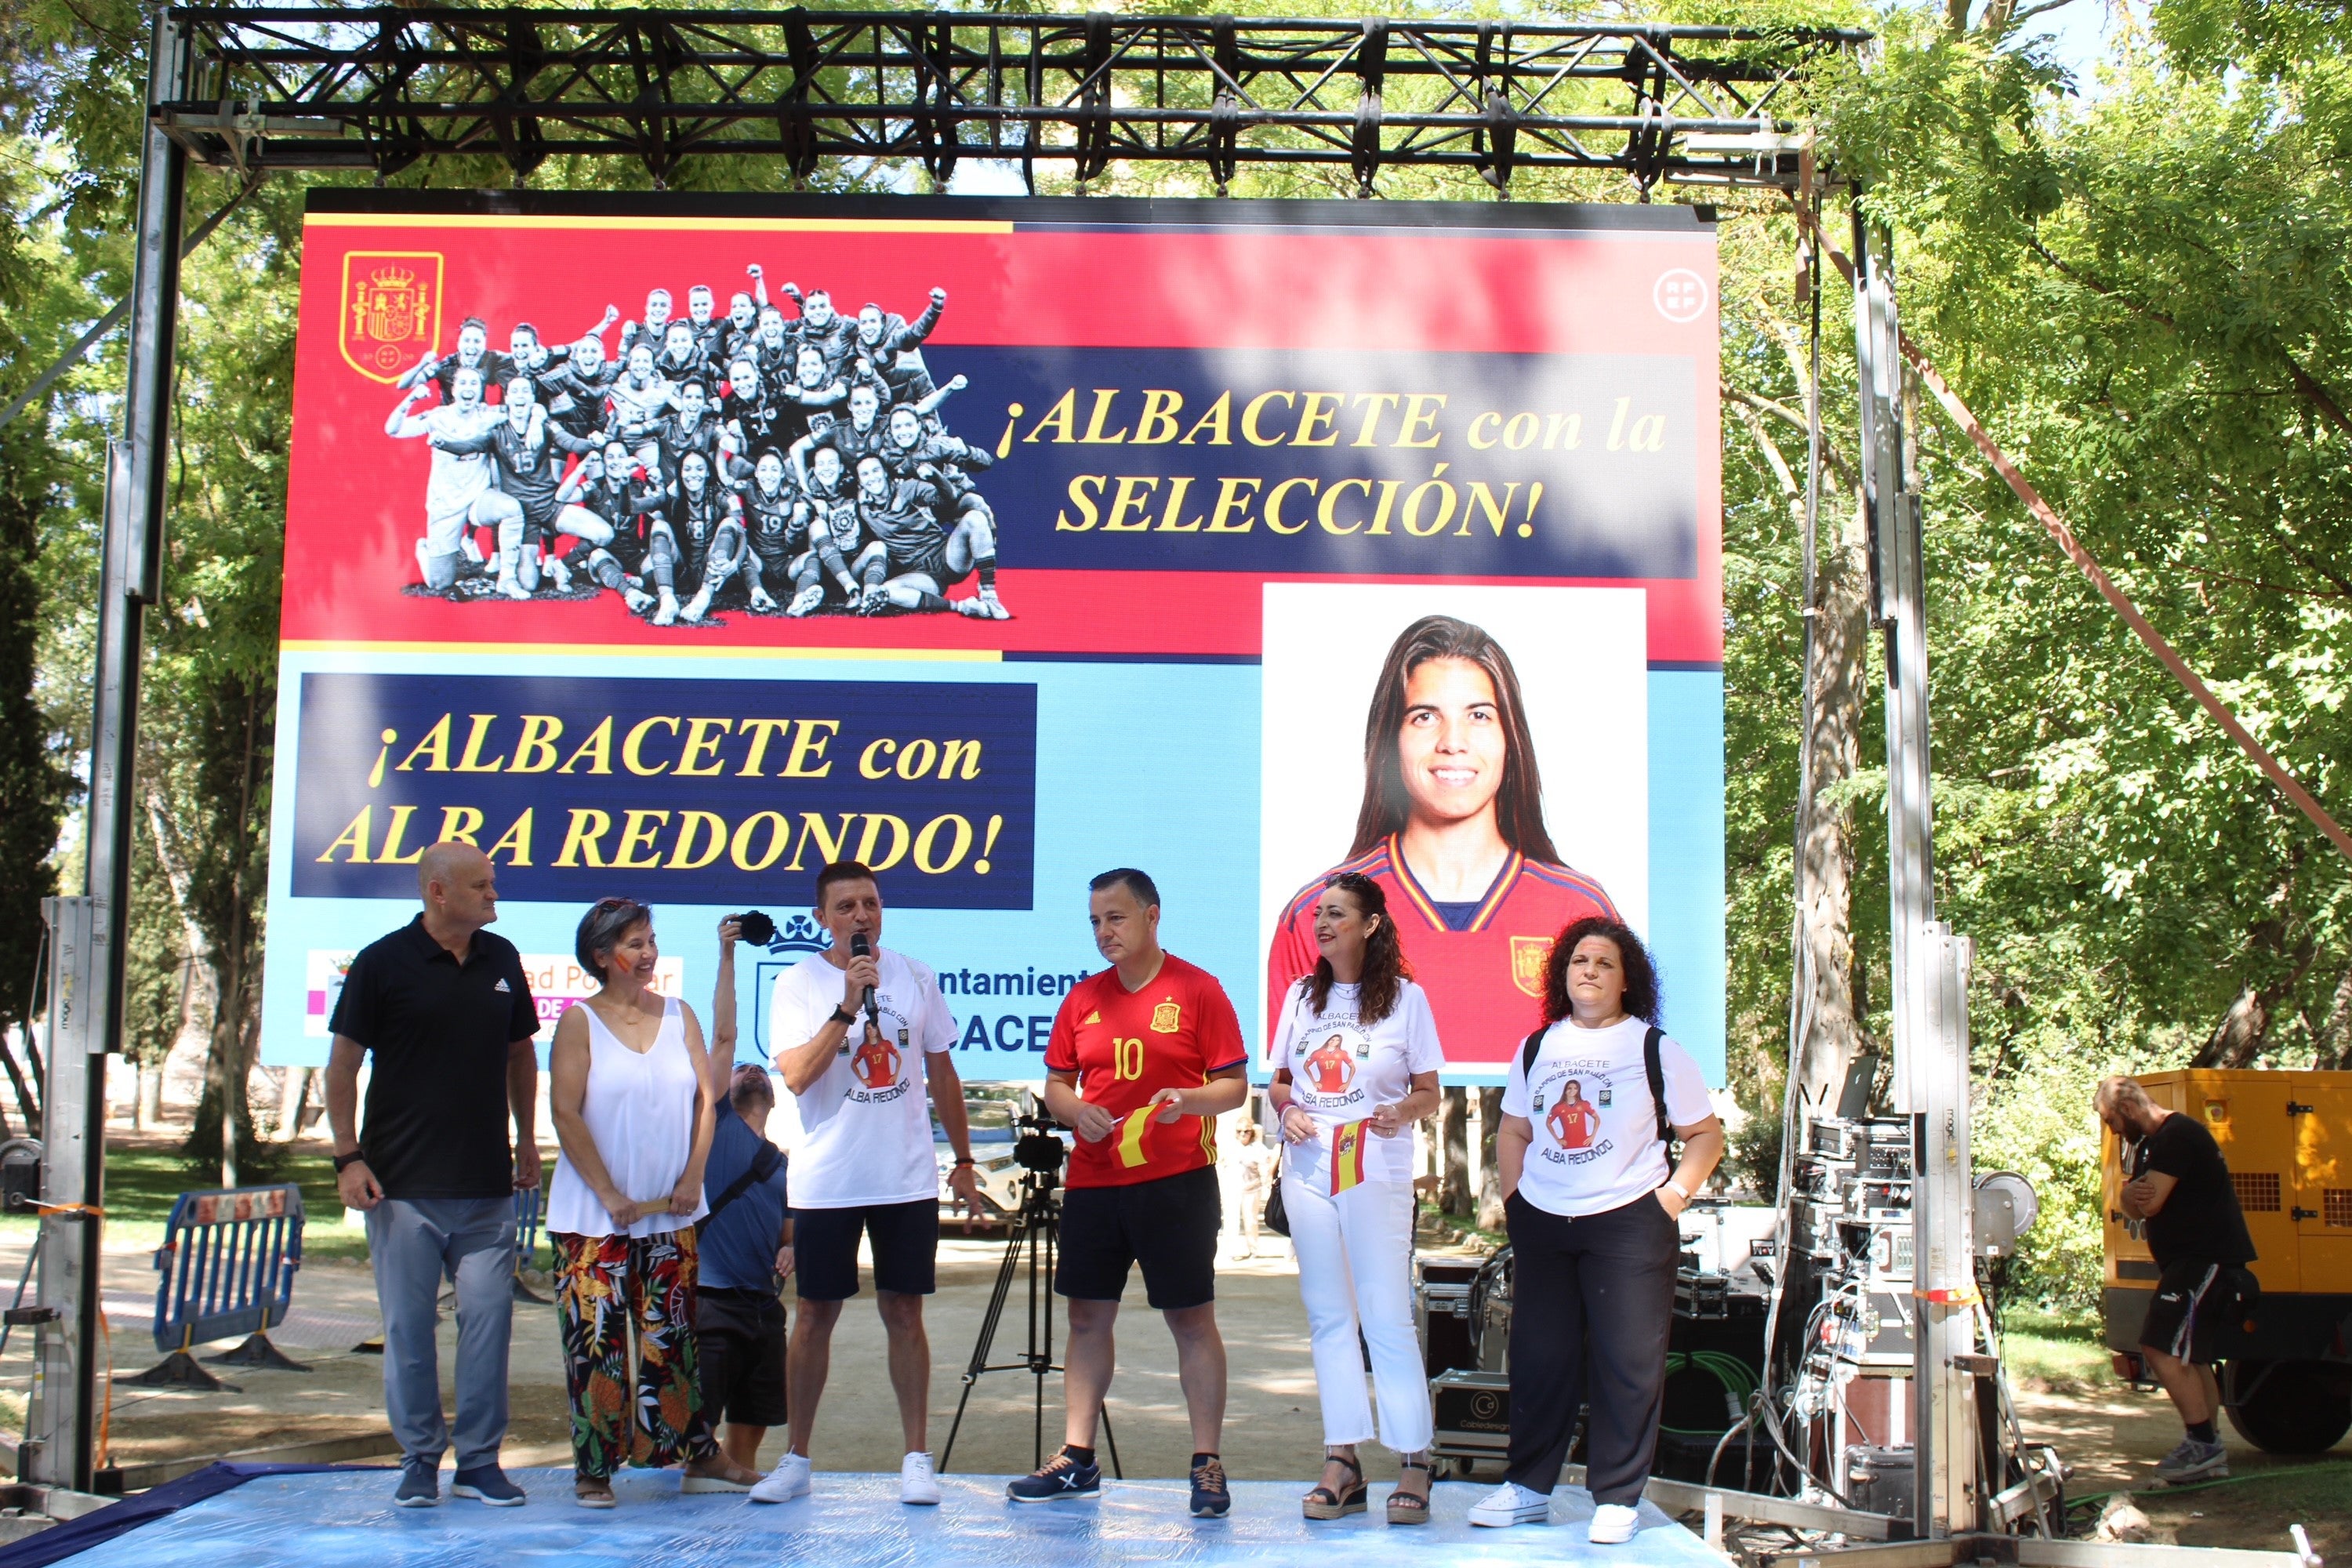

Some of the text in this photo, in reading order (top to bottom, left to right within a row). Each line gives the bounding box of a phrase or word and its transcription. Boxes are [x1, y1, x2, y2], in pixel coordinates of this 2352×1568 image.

[996, 388, 1667, 459] ¡ALBACETE con la
[513, 451, 535, 473] 15
[1055, 463, 1544, 539] SELECCIÓN!
[760, 514, 782, 534] 19
[368, 713, 982, 789] ¡ALBACETE con
[315, 804, 1004, 876] ALBA REDONDO!
[537, 999, 564, 1018] DE
[872, 1053, 882, 1065] 17
[1112, 1037, 1144, 1081] 10
[1324, 1060, 1336, 1070] 17
[1552, 1059, 1610, 1069] ALBACETE
[1557, 1069, 1567, 1078] DE
[844, 1077, 910, 1104] ALBA REDONDO
[1319, 1088, 1365, 1108] REDONDO
[1567, 1113, 1578, 1124] 17
[1541, 1139, 1613, 1165] ALBA REDONDO
